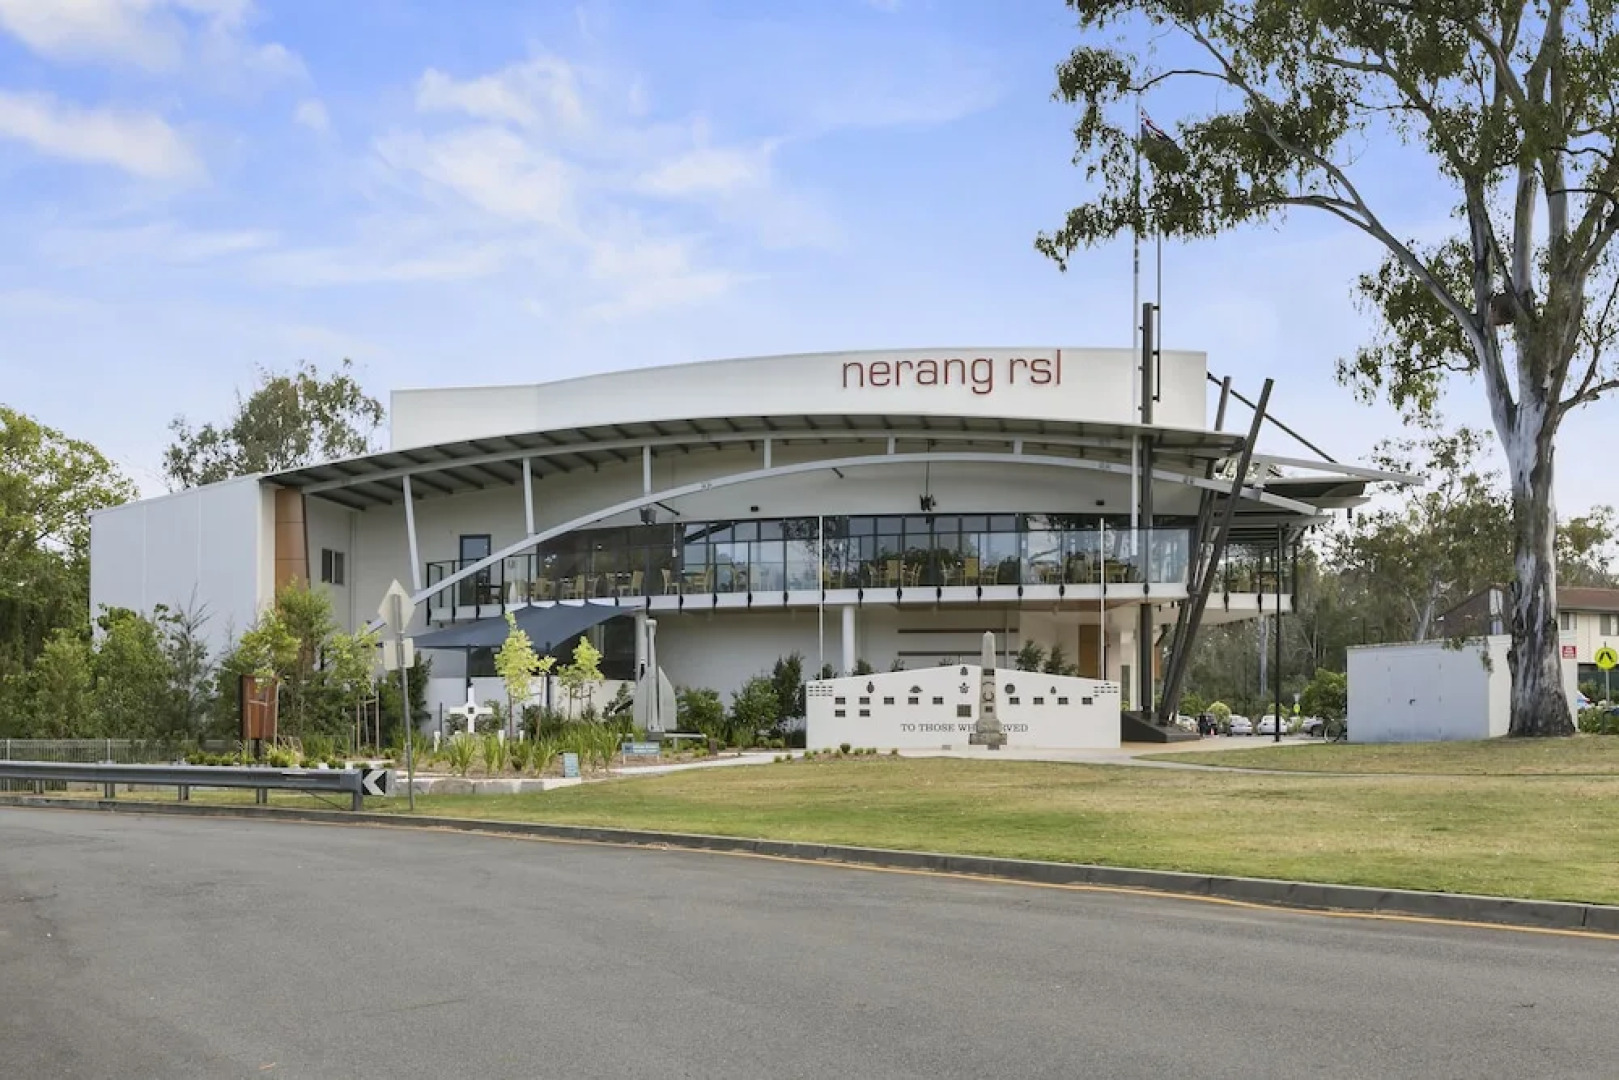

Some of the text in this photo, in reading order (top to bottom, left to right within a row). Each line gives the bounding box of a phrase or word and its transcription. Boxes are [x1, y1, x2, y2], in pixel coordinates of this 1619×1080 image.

[842, 349, 1061, 395] nerang rsl
[900, 723, 916, 732] TO
[918, 723, 955, 732] THOSE
[958, 723, 977, 732] WH
